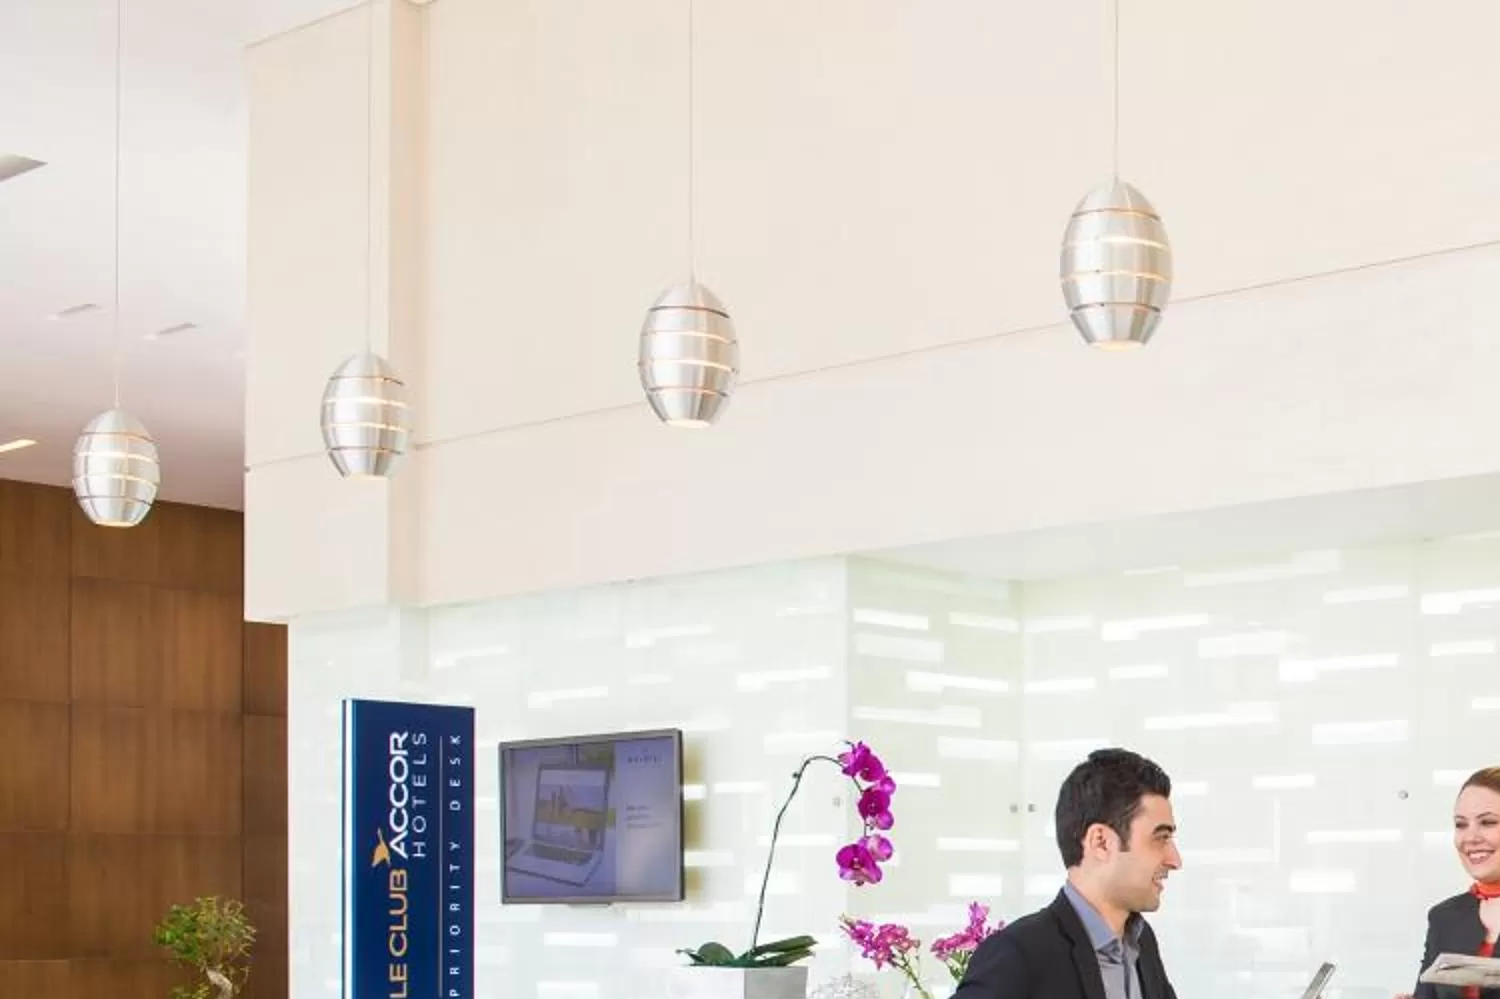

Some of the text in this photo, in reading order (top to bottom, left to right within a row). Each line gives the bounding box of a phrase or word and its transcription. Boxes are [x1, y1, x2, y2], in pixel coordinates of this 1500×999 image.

[389, 731, 409, 999] LE CLUB ACCOR
[412, 733, 427, 857] HOTELS
[449, 735, 461, 997] PRIORITY DESK
